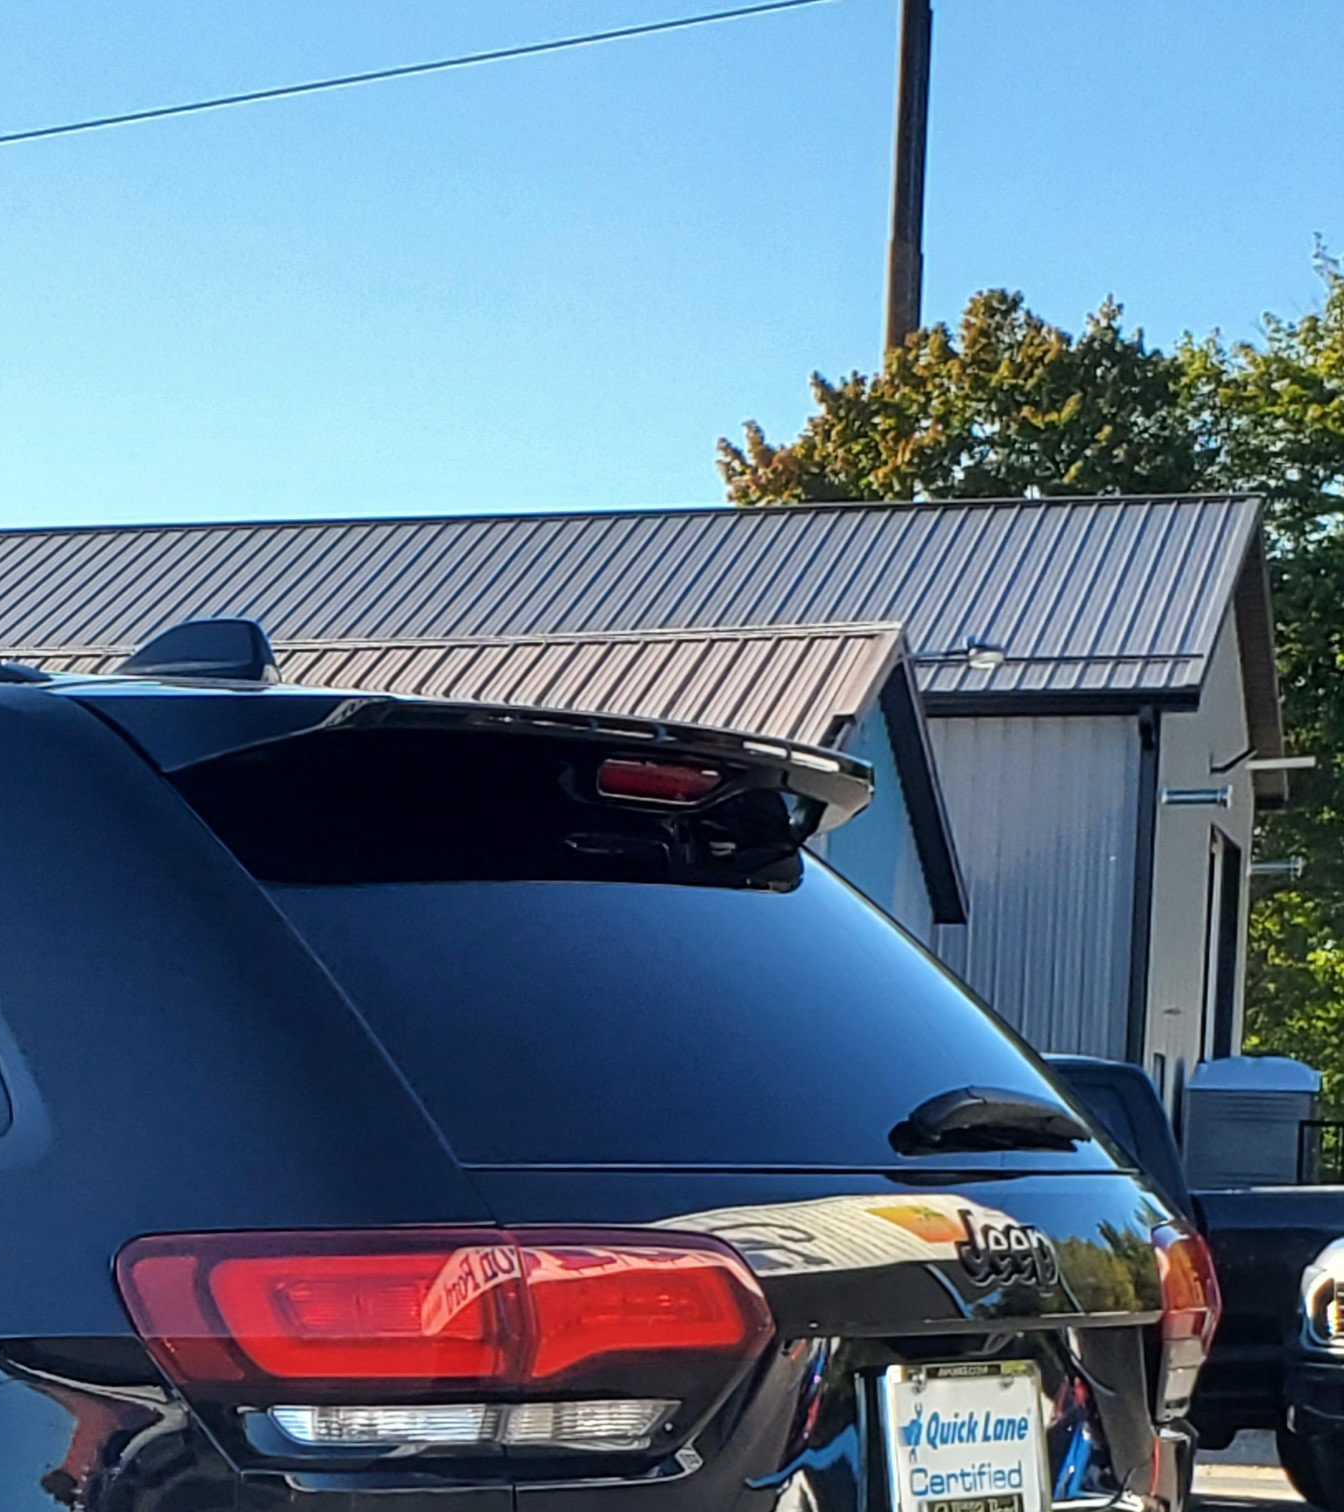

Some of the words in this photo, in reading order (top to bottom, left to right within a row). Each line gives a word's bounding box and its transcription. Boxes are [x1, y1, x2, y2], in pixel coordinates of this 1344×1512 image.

[955, 1208, 1059, 1292] Jeep
[925, 1411, 979, 1450] Quick
[981, 1410, 1029, 1442] Lane
[910, 1459, 1022, 1496] Certified
